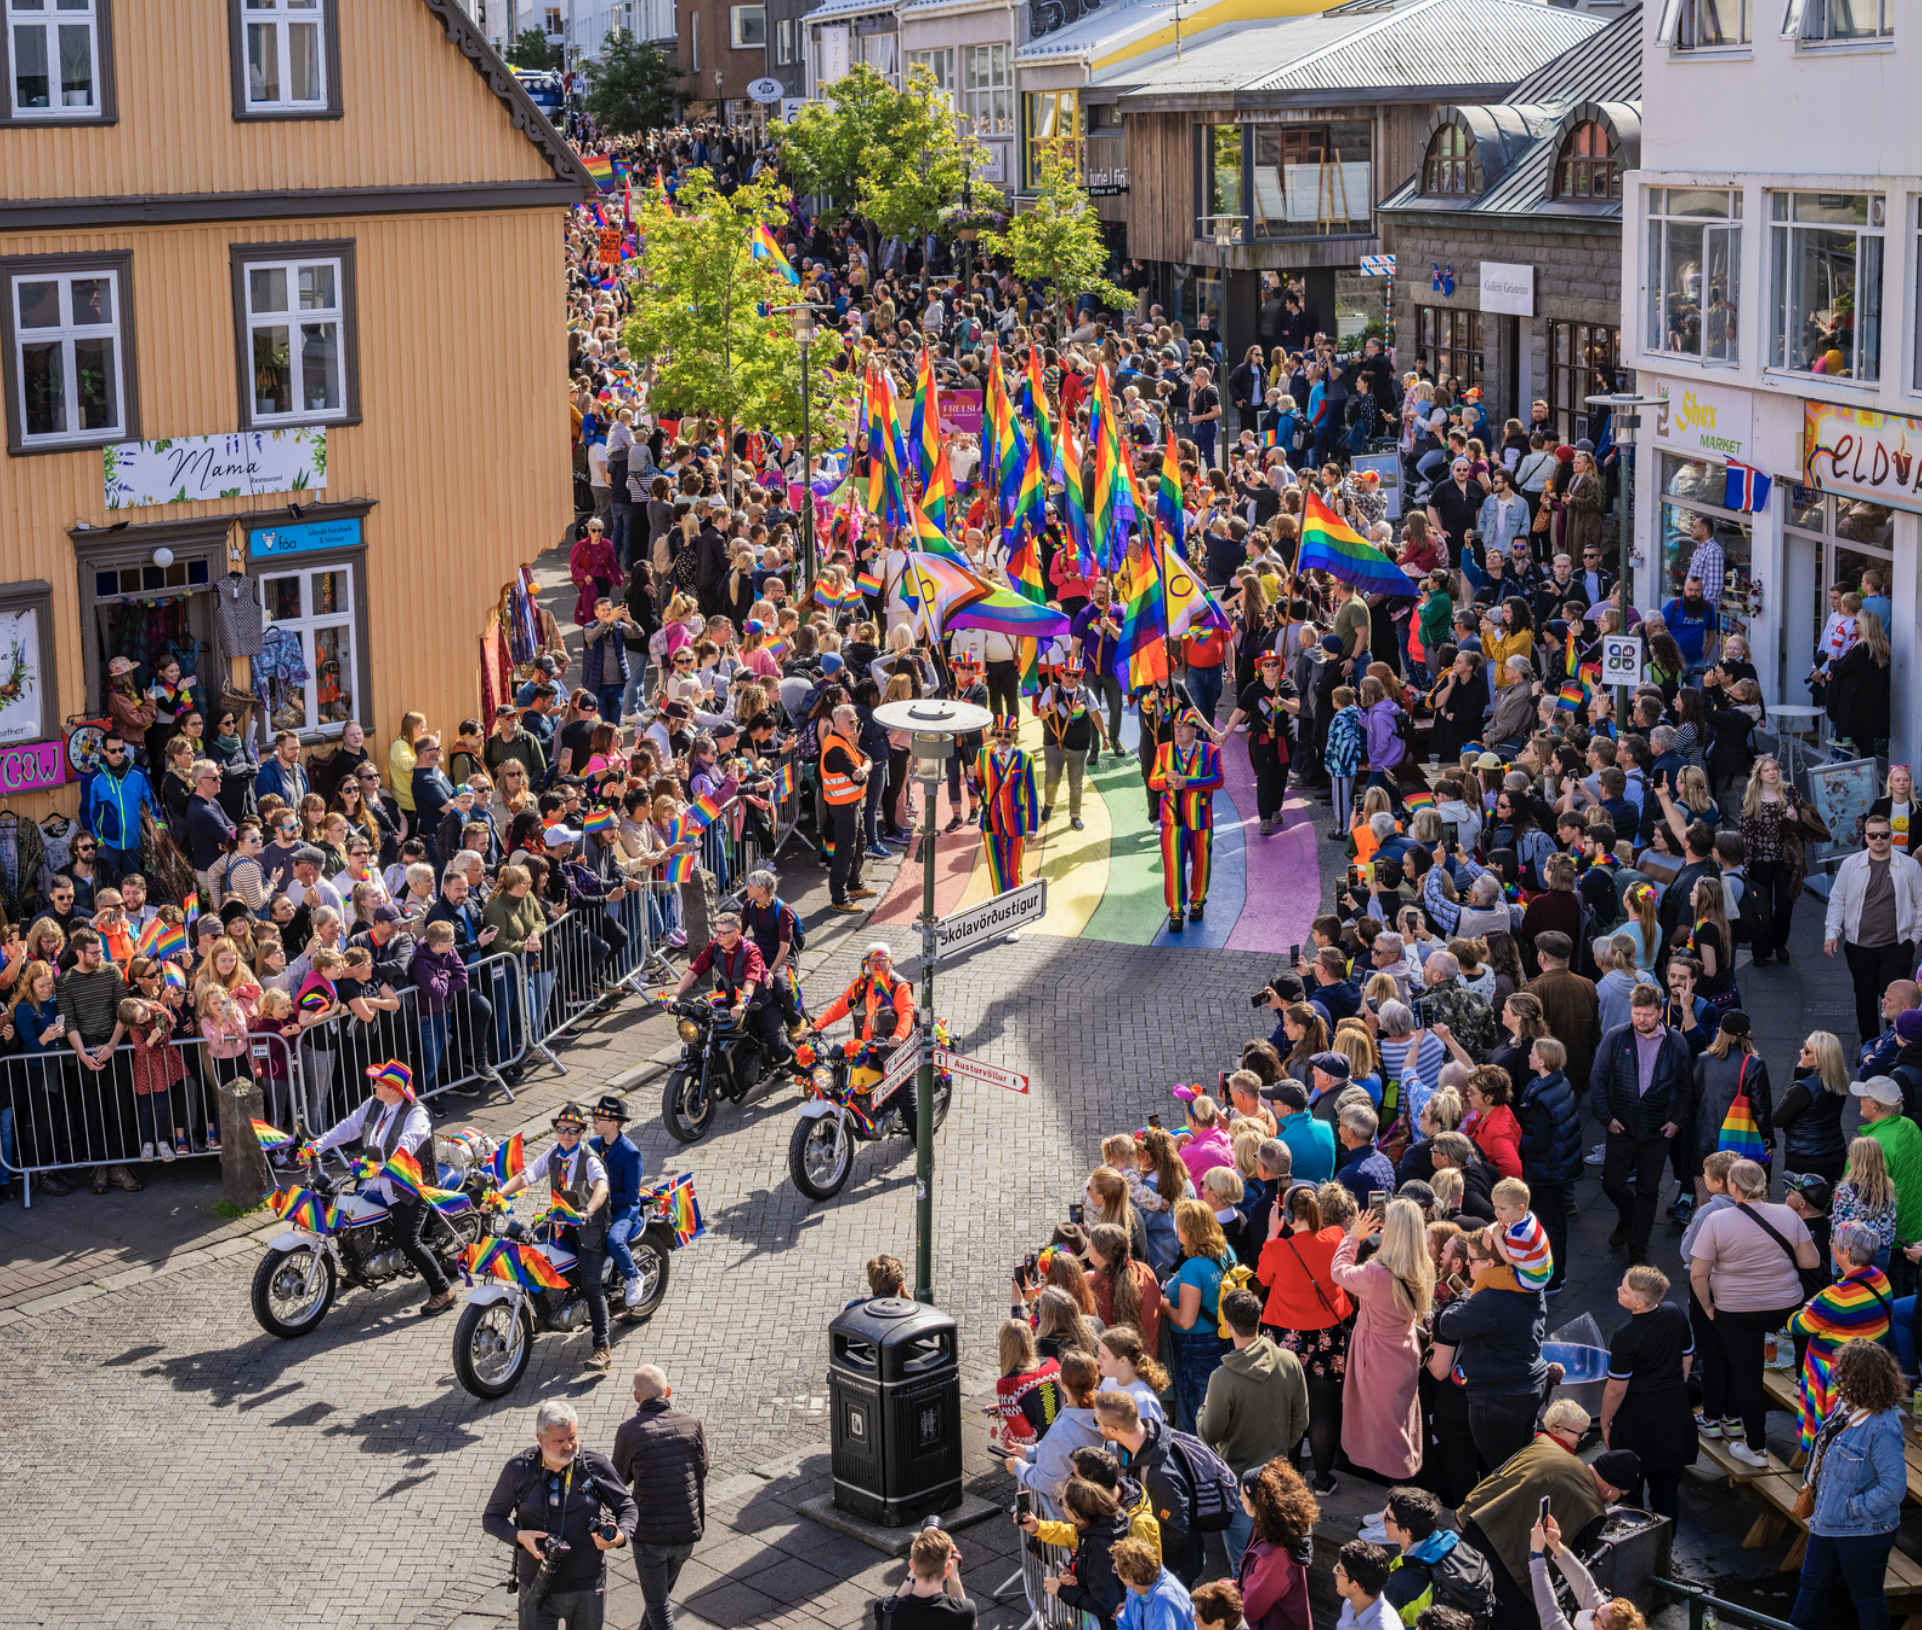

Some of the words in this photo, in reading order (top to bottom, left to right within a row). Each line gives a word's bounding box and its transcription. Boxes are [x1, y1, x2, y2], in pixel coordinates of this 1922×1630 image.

[1090, 187, 1106, 195] fine
[1674, 390, 1718, 432] Shex
[1699, 433, 1743, 455] MARKET
[167, 447, 262, 491] Mama
[250, 475, 283, 484] Restaurant
[279, 535, 297, 551] fóa
[954, 1059, 1008, 1083] Austurvöllur
